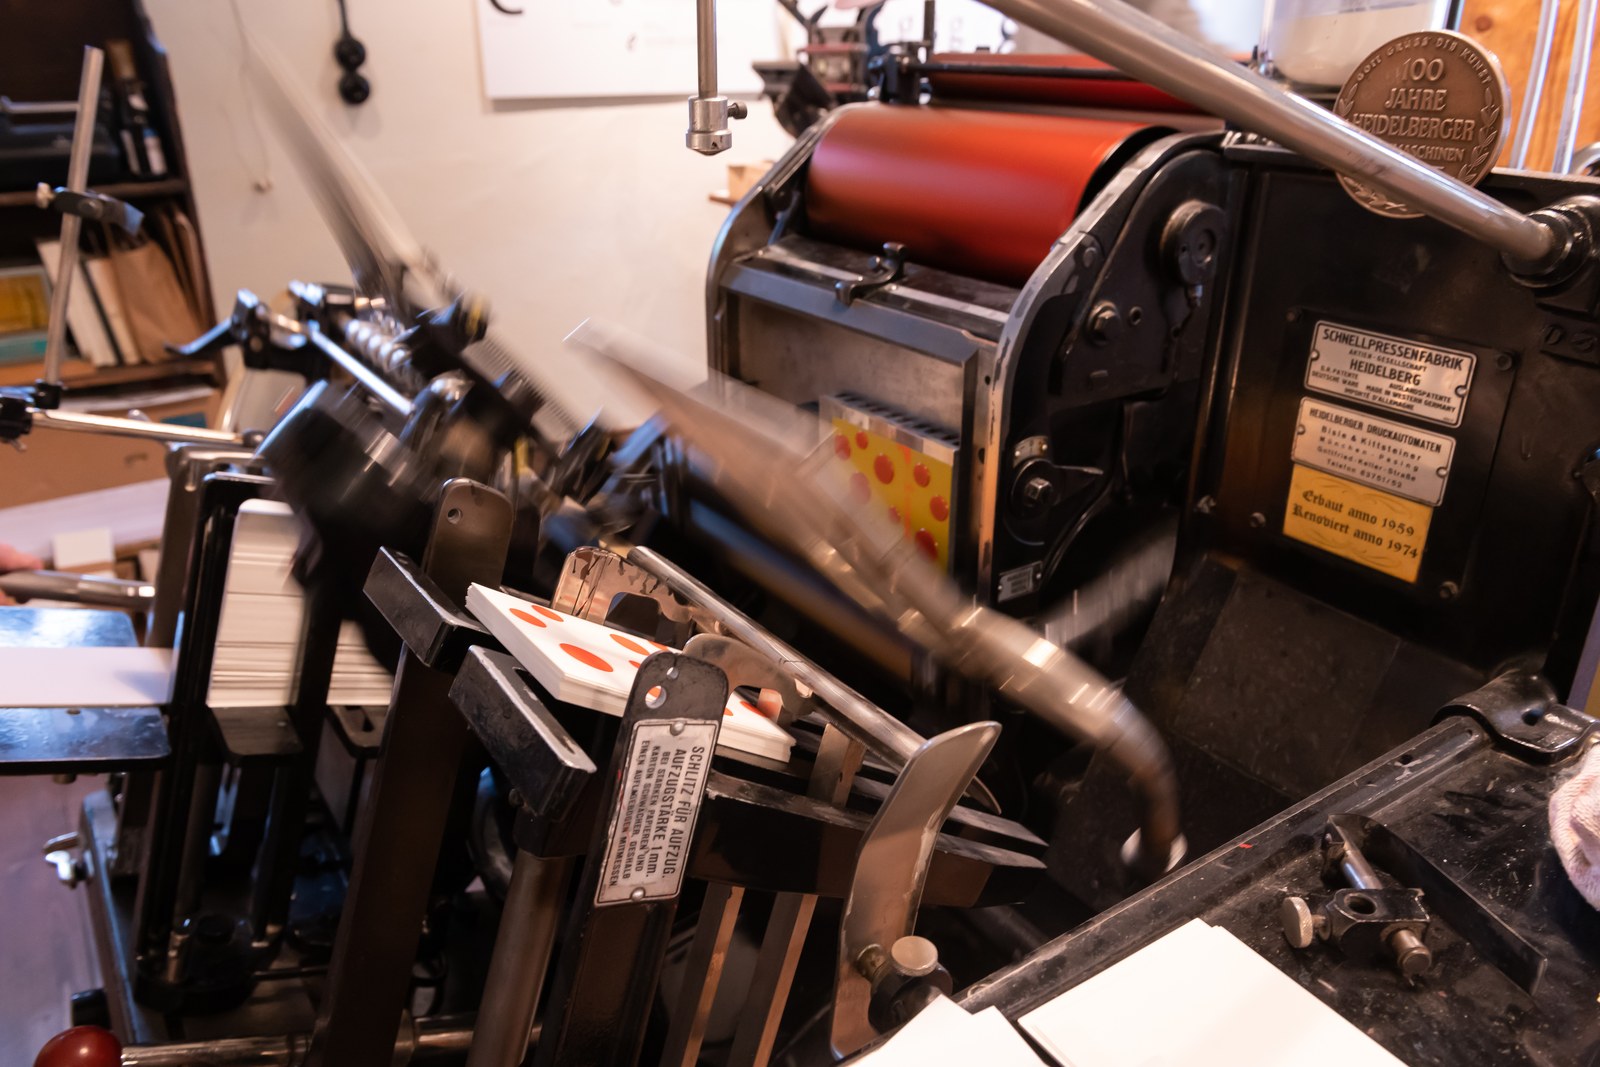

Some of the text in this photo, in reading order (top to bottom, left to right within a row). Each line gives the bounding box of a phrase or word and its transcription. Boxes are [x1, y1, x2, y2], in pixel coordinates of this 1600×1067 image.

[1401, 57, 1445, 82] 100
[1384, 87, 1447, 111] JAHRE
[1351, 113, 1475, 141] HEIDELBERGER
[1322, 328, 1464, 371] SCHNELLPRESSENFABRIK
[1311, 370, 1359, 388] DEUTSCHE WARE
[1349, 359, 1421, 386] HEIDELBERG
[1366, 385, 1382, 394] MADE
[1392, 391, 1422, 404] WESTERN
[1424, 400, 1456, 413] GERMANY
[1389, 383, 1452, 403] AUSLANDSPATENTE
[1309, 408, 1442, 453] HEIDELBERGER DRUCKAUTOMATEN
[1327, 458, 1356, 473] Telefon
[1302, 489, 1415, 537] Erbaut anno 1959
[1292, 503, 1418, 559] Renoviert anno 1974
[637, 740, 651, 766] EINEN
[645, 745, 661, 779] KARTON
[659, 751, 671, 765] BEI
[653, 748, 687, 841] AUFZUGSTÄRKE
[661, 746, 705, 878] SCHLITZ FÜR AUFZUG.
[640, 809, 656, 850] PAPIEREN
[622, 841, 638, 880] DESHALB
[635, 854, 645, 872] UND
